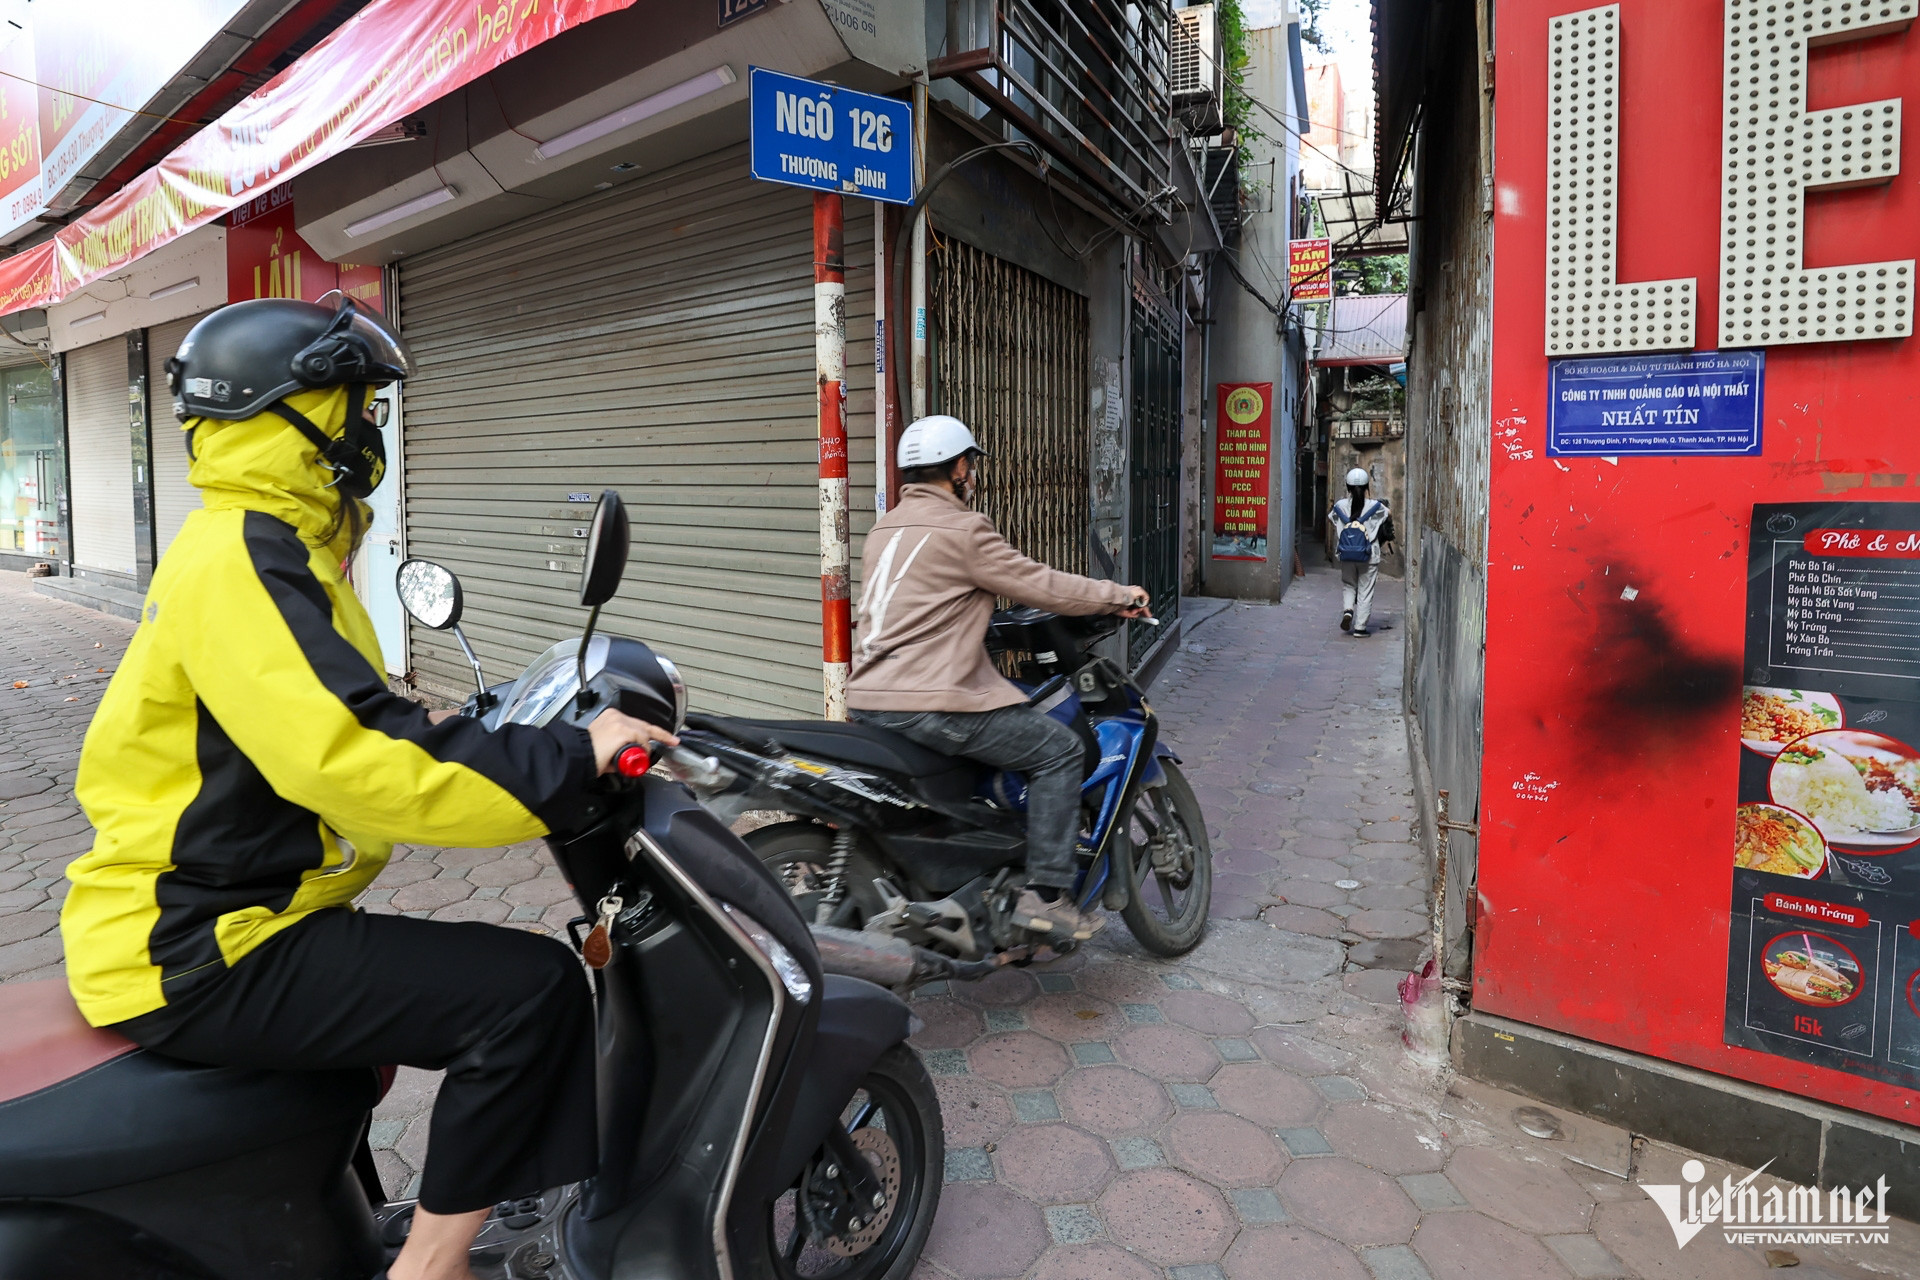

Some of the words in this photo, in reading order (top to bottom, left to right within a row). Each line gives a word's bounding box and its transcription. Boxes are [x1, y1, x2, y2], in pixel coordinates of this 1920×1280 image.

[775, 90, 834, 142] NGÕ
[848, 107, 893, 153] 126
[779, 153, 838, 183] THƯỢNG
[853, 164, 887, 190] ĐÌNH
[1590, 365, 1619, 375] HOẠCH
[1620, 365, 1628, 373] &
[1629, 361, 1648, 372] ĐẦU
[1649, 362, 1662, 372] TƯ
[1662, 361, 1694, 371] THÀNH
[1695, 357, 1716, 369] PHỐ
[1716, 360, 1730, 369] HÀ
[1732, 358, 1750, 369] NỘI
[1561, 388, 1587, 402] CÔNG
[1588, 389, 1600, 401] TY
[1602, 388, 1627, 400] TNHH
[1629, 383, 1662, 401] QUẢNG
[1664, 384, 1685, 399] CÁO
[1687, 383, 1701, 398] VÀ
[1702, 382, 1721, 400] NỘI
[1723, 379, 1750, 397] THẤT
[1601, 402, 1659, 427] NHẤT
[1662, 403, 1700, 426] TÍN
[1226, 429, 1247, 439] THAM
[1248, 429, 1261, 439] GIA
[1583, 437, 1605, 446] Thượng
[1629, 437, 1652, 446] Thượng
[1678, 435, 1698, 444] Thanh
[1220, 455, 1245, 465] PHONG
[1246, 453, 1265, 465] TRÀO
[1224, 468, 1243, 479] TOÀN
[1244, 468, 1261, 479] DÂN
[1231, 482, 1252, 492] PCCC
[1225, 495, 1245, 507] HẠNH
[1246, 493, 1267, 506] PHÚC
[1225, 505, 1240, 518] CỦA
[1224, 522, 1237, 532] GIA
[1238, 520, 1257, 532] ĐÌNH
[1821, 531, 1861, 549] Phở
[1866, 534, 1889, 552] &
[1789, 560, 1807, 571] Phở
[1808, 560, 1820, 571] Bò
[1822, 561, 1835, 572] Tái
[1788, 571, 1806, 583] Phở
[1807, 572, 1820, 583] Bò
[1821, 573, 1842, 585] Chín
[1787, 583, 1810, 595] Bánh
[1811, 585, 1822, 596] Mì
[1823, 585, 1836, 597] Bò
[1837, 586, 1853, 597] Sốt
[1855, 587, 1878, 600] Vang
[1801, 597, 1814, 607] Bò
[1815, 597, 1831, 608] Sốt
[1832, 598, 1855, 611] Vang
[1801, 608, 1813, 619] Bò
[1814, 609, 1842, 623] Trứng
[1800, 620, 1828, 634] Trứng
[1799, 633, 1817, 644] Xào
[1818, 634, 1830, 645] Bò
[1785, 643, 1812, 657] Trứng
[1775, 897, 1803, 912] Bánh
[1805, 902, 1818, 914] Mì
[1820, 905, 1855, 924] Trứng
[1793, 1014, 1824, 1037] 15k
